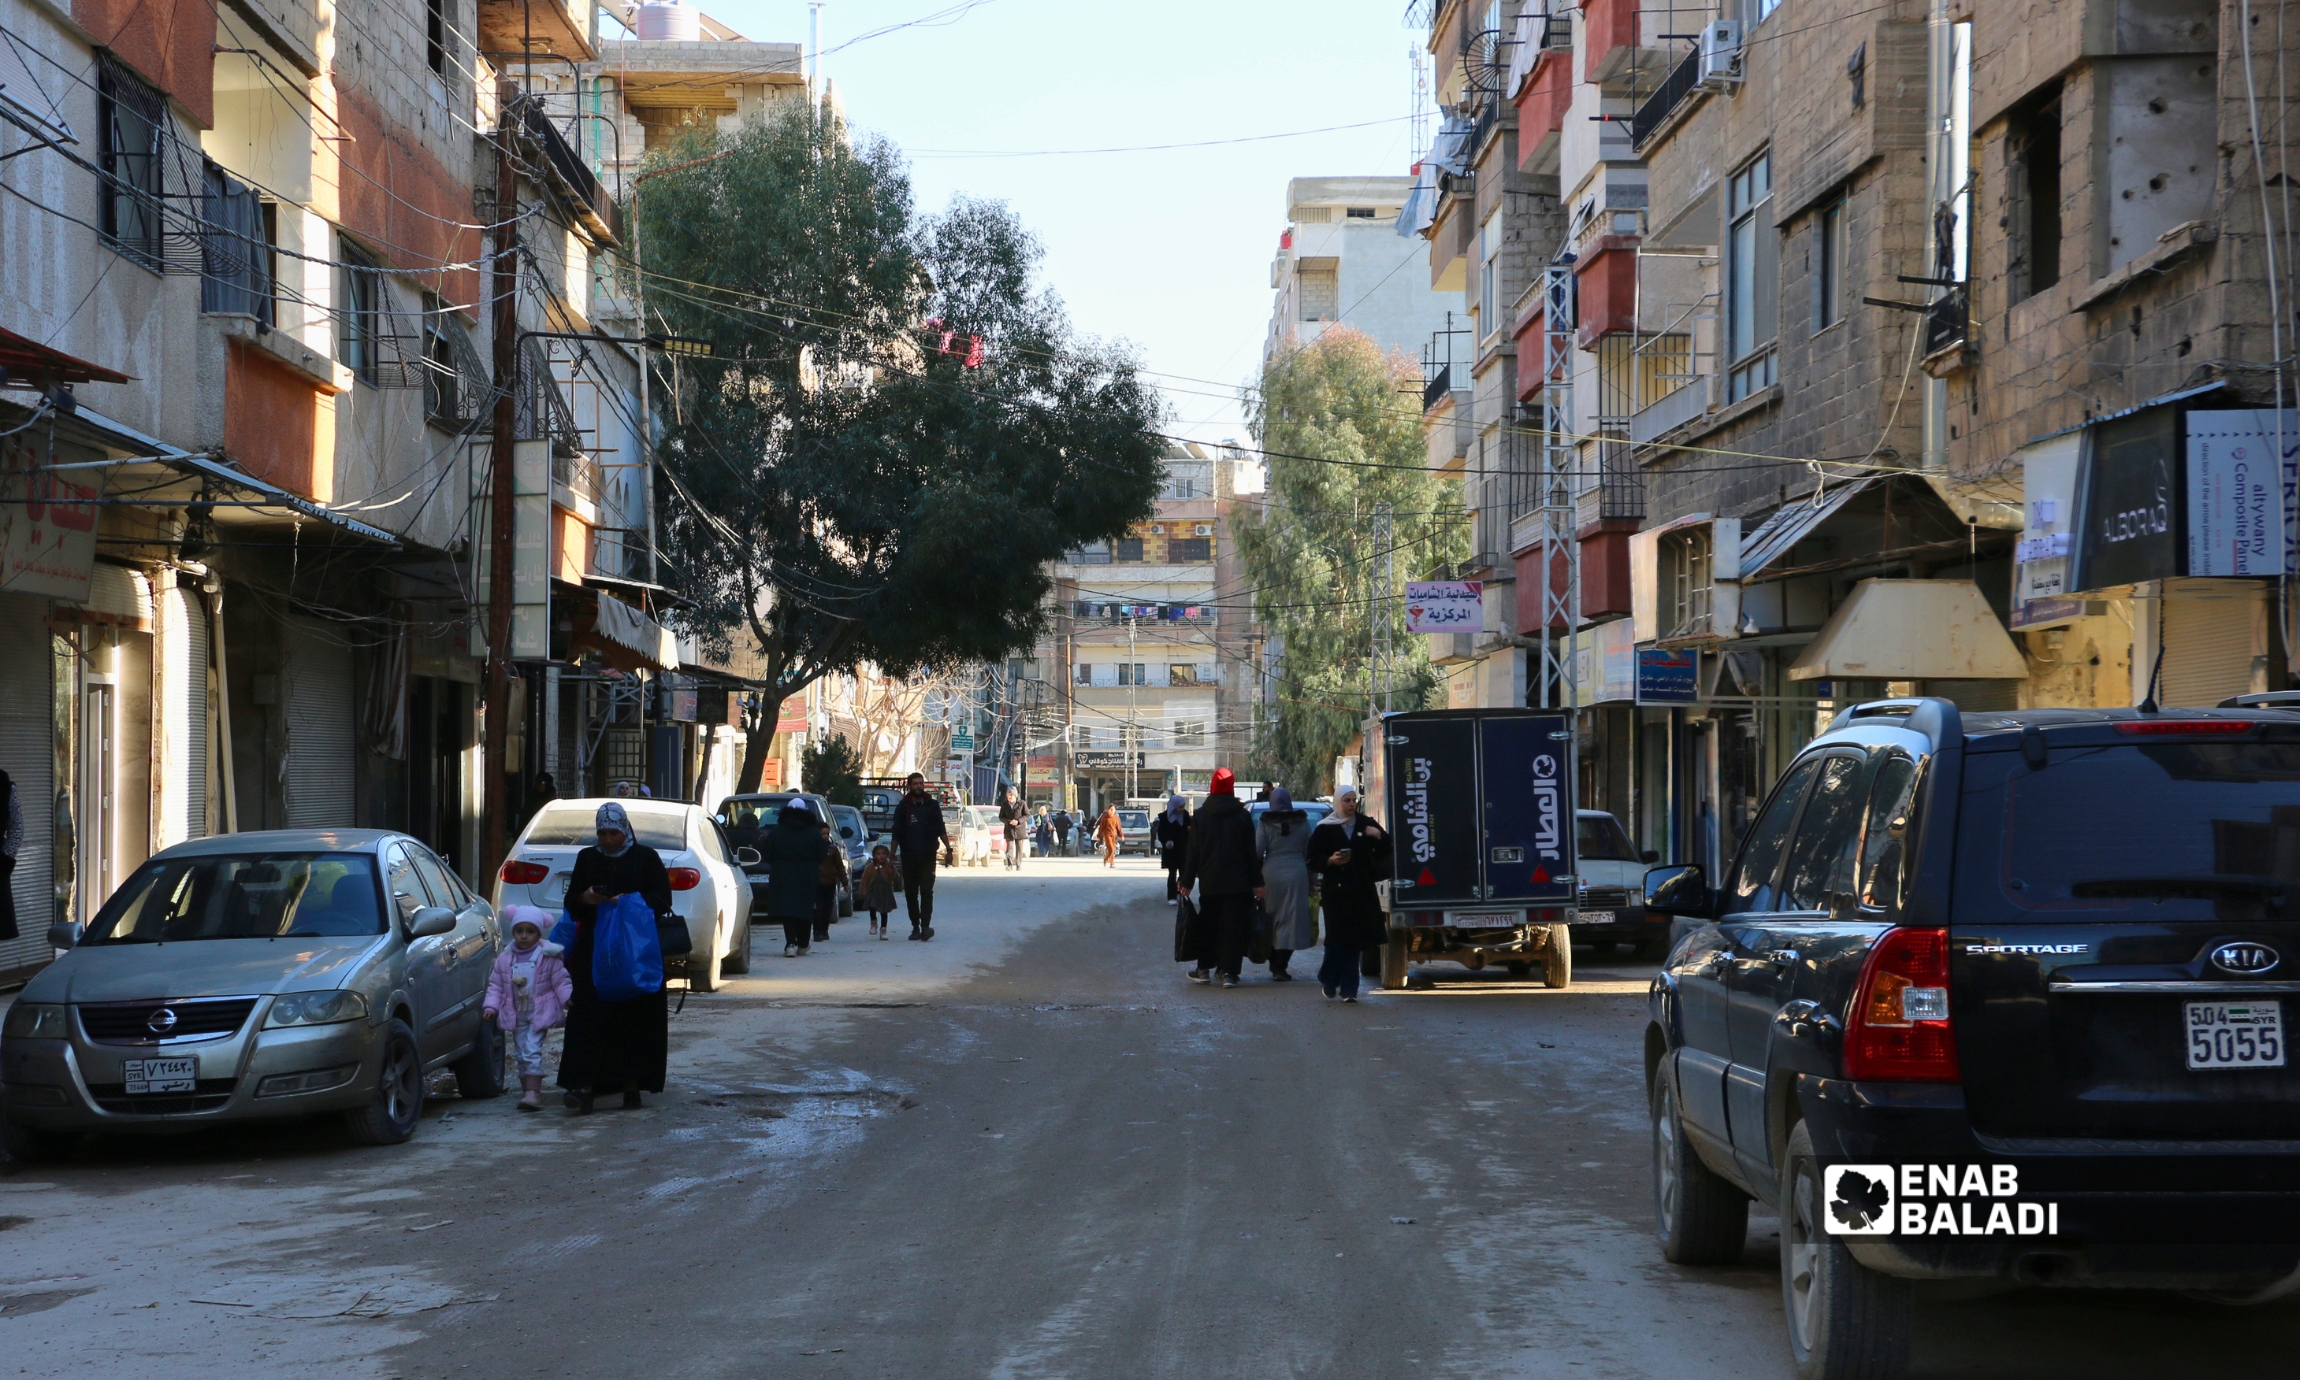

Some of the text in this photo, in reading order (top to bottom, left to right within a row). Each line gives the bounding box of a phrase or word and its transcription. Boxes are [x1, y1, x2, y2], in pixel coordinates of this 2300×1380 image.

[2202, 442, 2211, 476] direction
[2202, 478, 2211, 486] of
[2203, 488, 2211, 500] the
[2231, 463, 2250, 537] Composite
[2102, 503, 2168, 543] ALBORAQ
[2250, 484, 2268, 557] altywany
[2202, 525, 2211, 551] please
[1409, 585, 1478, 602] صيدلية الشاميات
[1428, 607, 1470, 622] المركزية
[1402, 757, 1436, 863] بن الشامي
[1533, 778, 1560, 861] العطار
[1966, 944, 2089, 956] SPORTAGE
[2222, 949, 2269, 967] KIA
[2253, 1017, 2277, 1025] SYR
[2192, 1026, 2279, 1063] 5055
[128, 1072, 142, 1081] SYR
